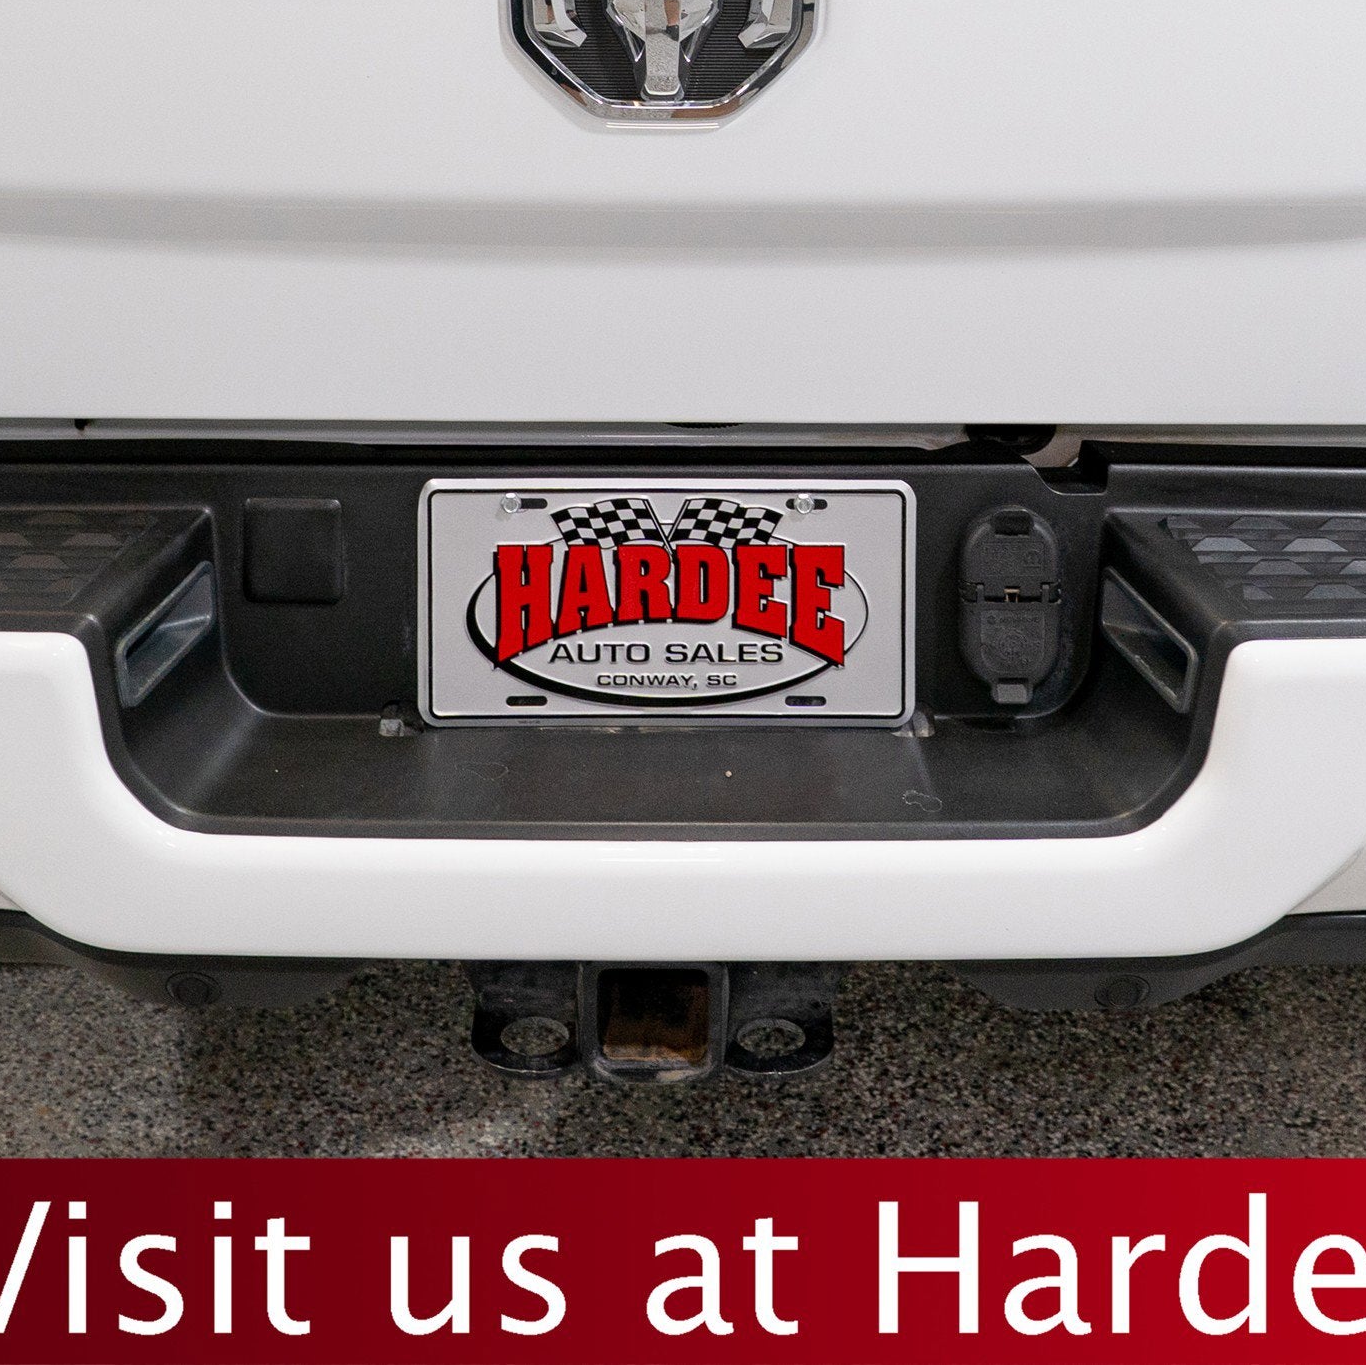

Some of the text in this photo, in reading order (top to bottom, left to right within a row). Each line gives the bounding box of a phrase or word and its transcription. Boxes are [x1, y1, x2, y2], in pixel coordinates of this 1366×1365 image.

[493, 544, 846, 669] HARDEE
[549, 643, 784, 664] AUTO SALES
[597, 675, 738, 690] CONWAY, SC
